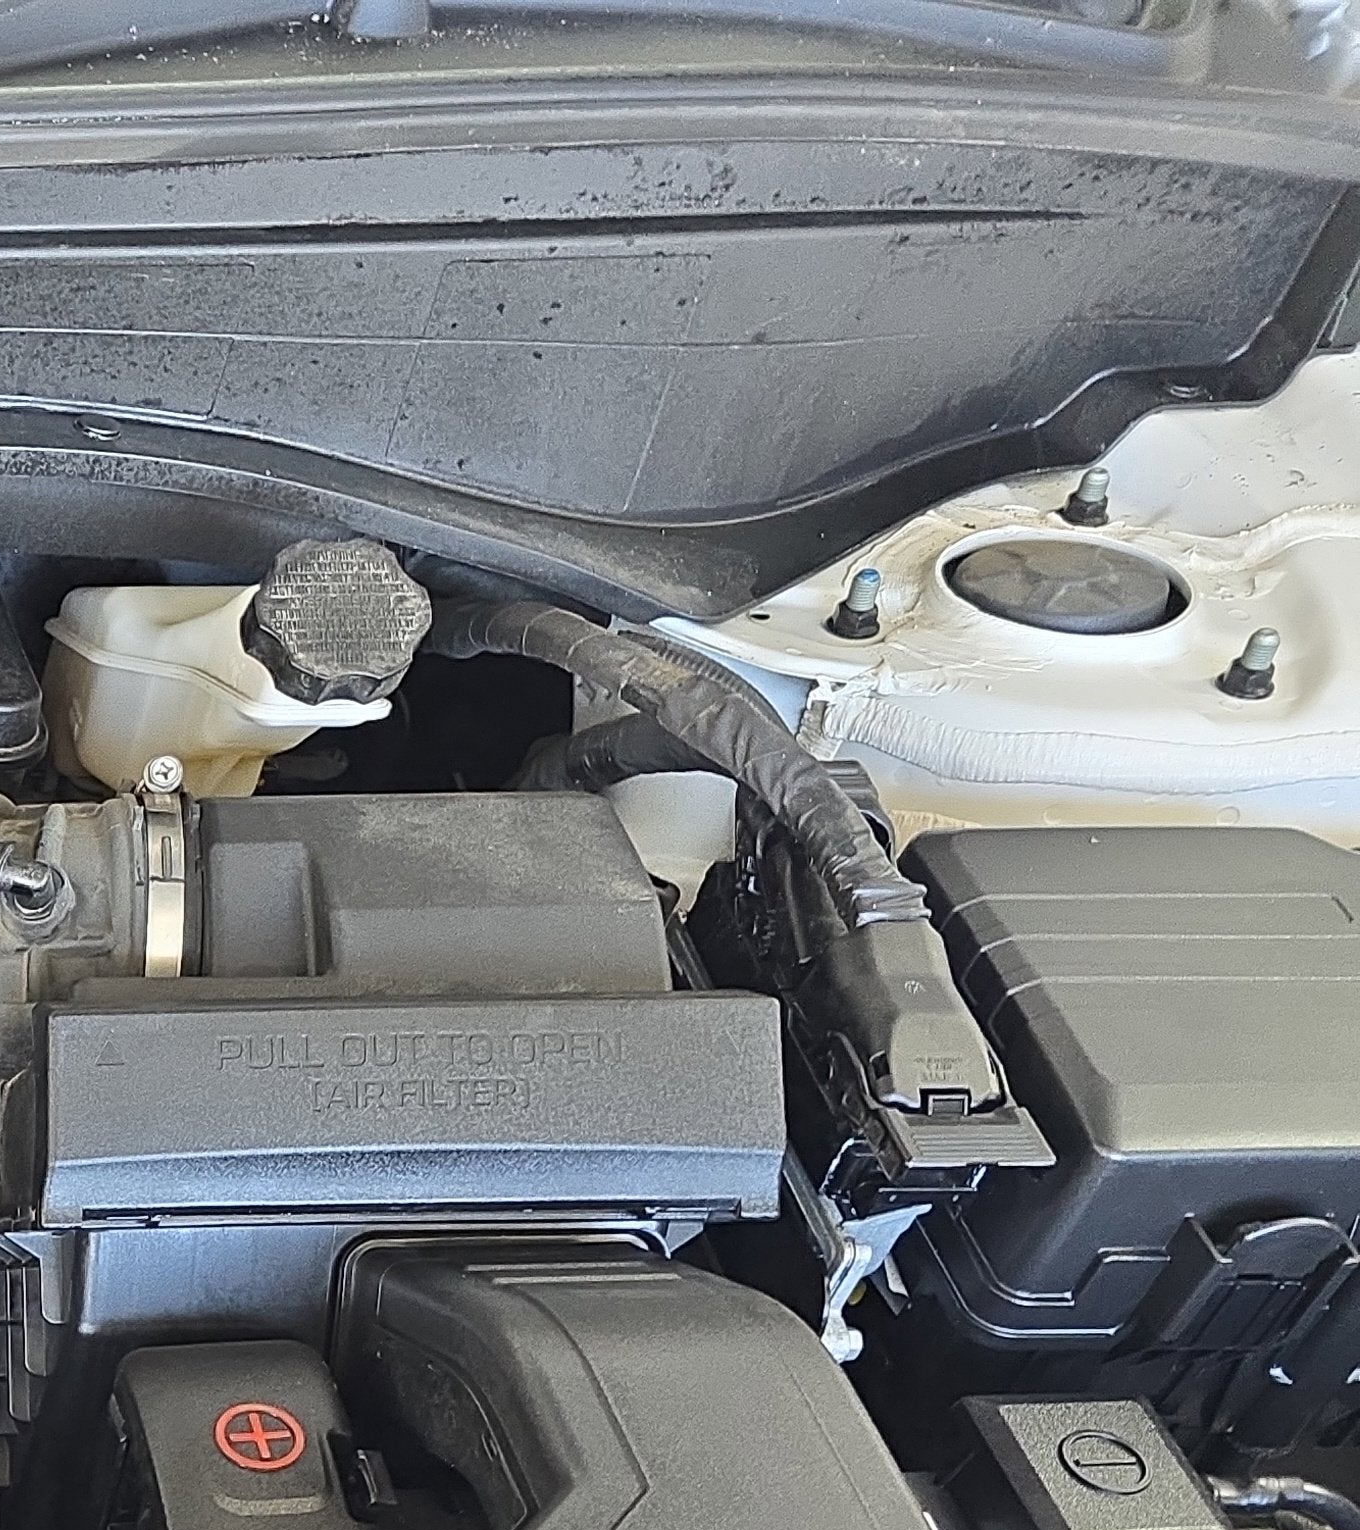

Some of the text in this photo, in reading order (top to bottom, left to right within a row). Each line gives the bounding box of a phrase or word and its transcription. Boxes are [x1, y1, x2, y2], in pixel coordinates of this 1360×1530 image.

[217, 1030, 624, 1070] PULL OUT TO OPEN
